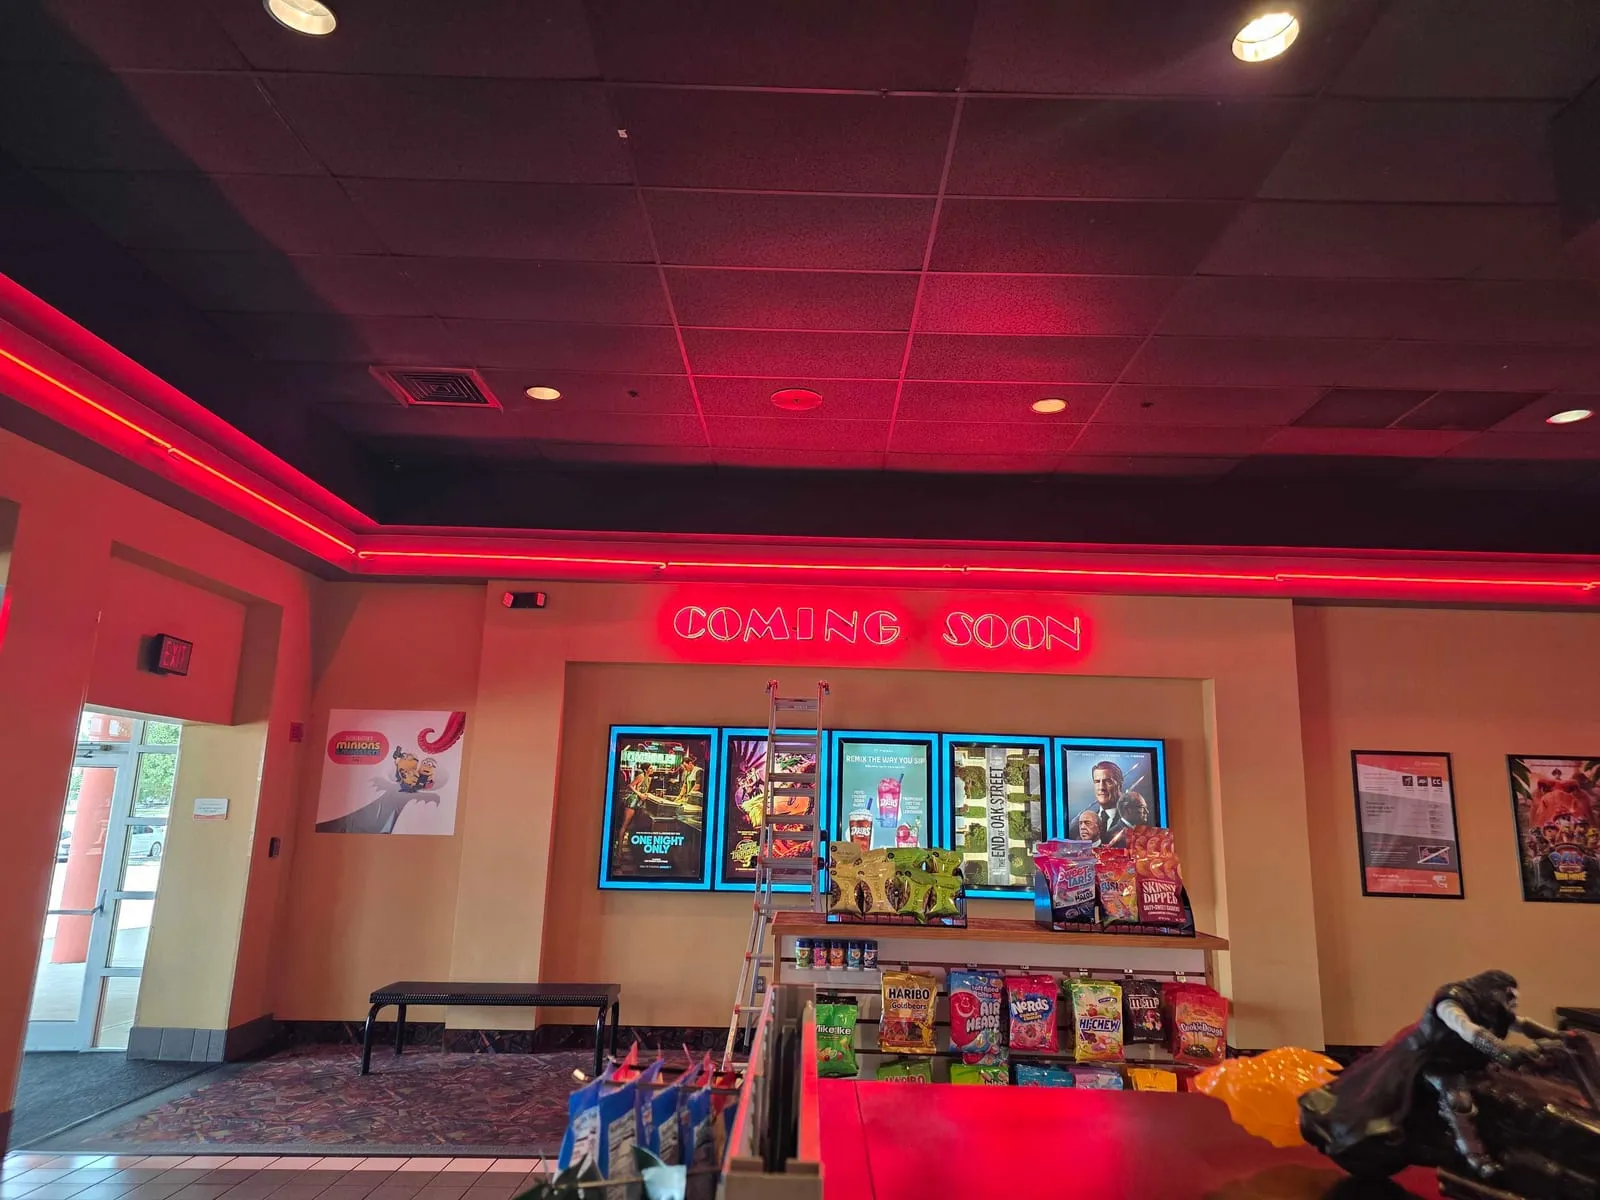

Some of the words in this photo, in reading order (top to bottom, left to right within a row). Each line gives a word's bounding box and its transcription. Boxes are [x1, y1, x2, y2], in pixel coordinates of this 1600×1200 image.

[674, 606, 900, 645] COMING
[942, 611, 1081, 651] SOON
[163, 640, 188, 668] EXIT
[336, 741, 380, 750] minions
[846, 755, 867, 764] REMIX
[868, 756, 880, 764] THE
[881, 756, 898, 765] WAY
[898, 757, 913, 765] YOU
[989, 767, 1005, 805] STREET
[990, 807, 1005, 829] OAK
[631, 835, 653, 845] ONE
[653, 835, 685, 846] NIGHT
[991, 836, 1006, 858] END
[643, 844, 671, 854] ONLY
[1142, 881, 1177, 894] SKINNY
[888, 988, 930, 1000] HARIBO
[980, 1001, 1000, 1016] AIR
[966, 1015, 1000, 1033] HEADS
[1079, 1018, 1121, 1031] HI-CHEW
[1202, 1023, 1224, 1037] Dough
